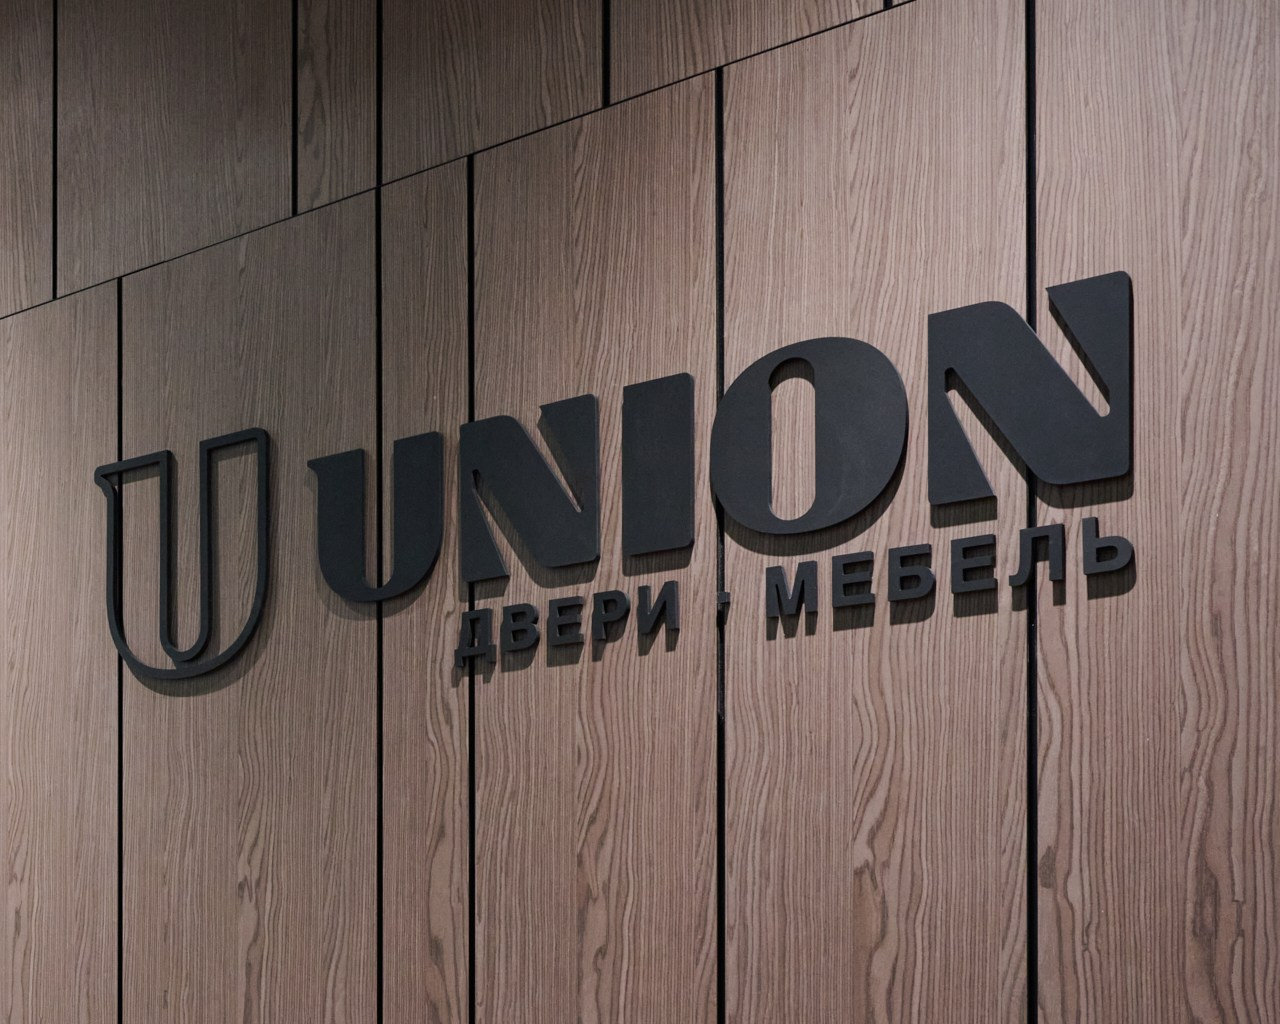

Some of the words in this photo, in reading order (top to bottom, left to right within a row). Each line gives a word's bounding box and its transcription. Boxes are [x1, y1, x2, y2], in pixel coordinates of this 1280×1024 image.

[307, 271, 1133, 604] UNION
[455, 580, 680, 668] ДВЕРИ
[765, 517, 1134, 619] МЕБЕЛЬ
